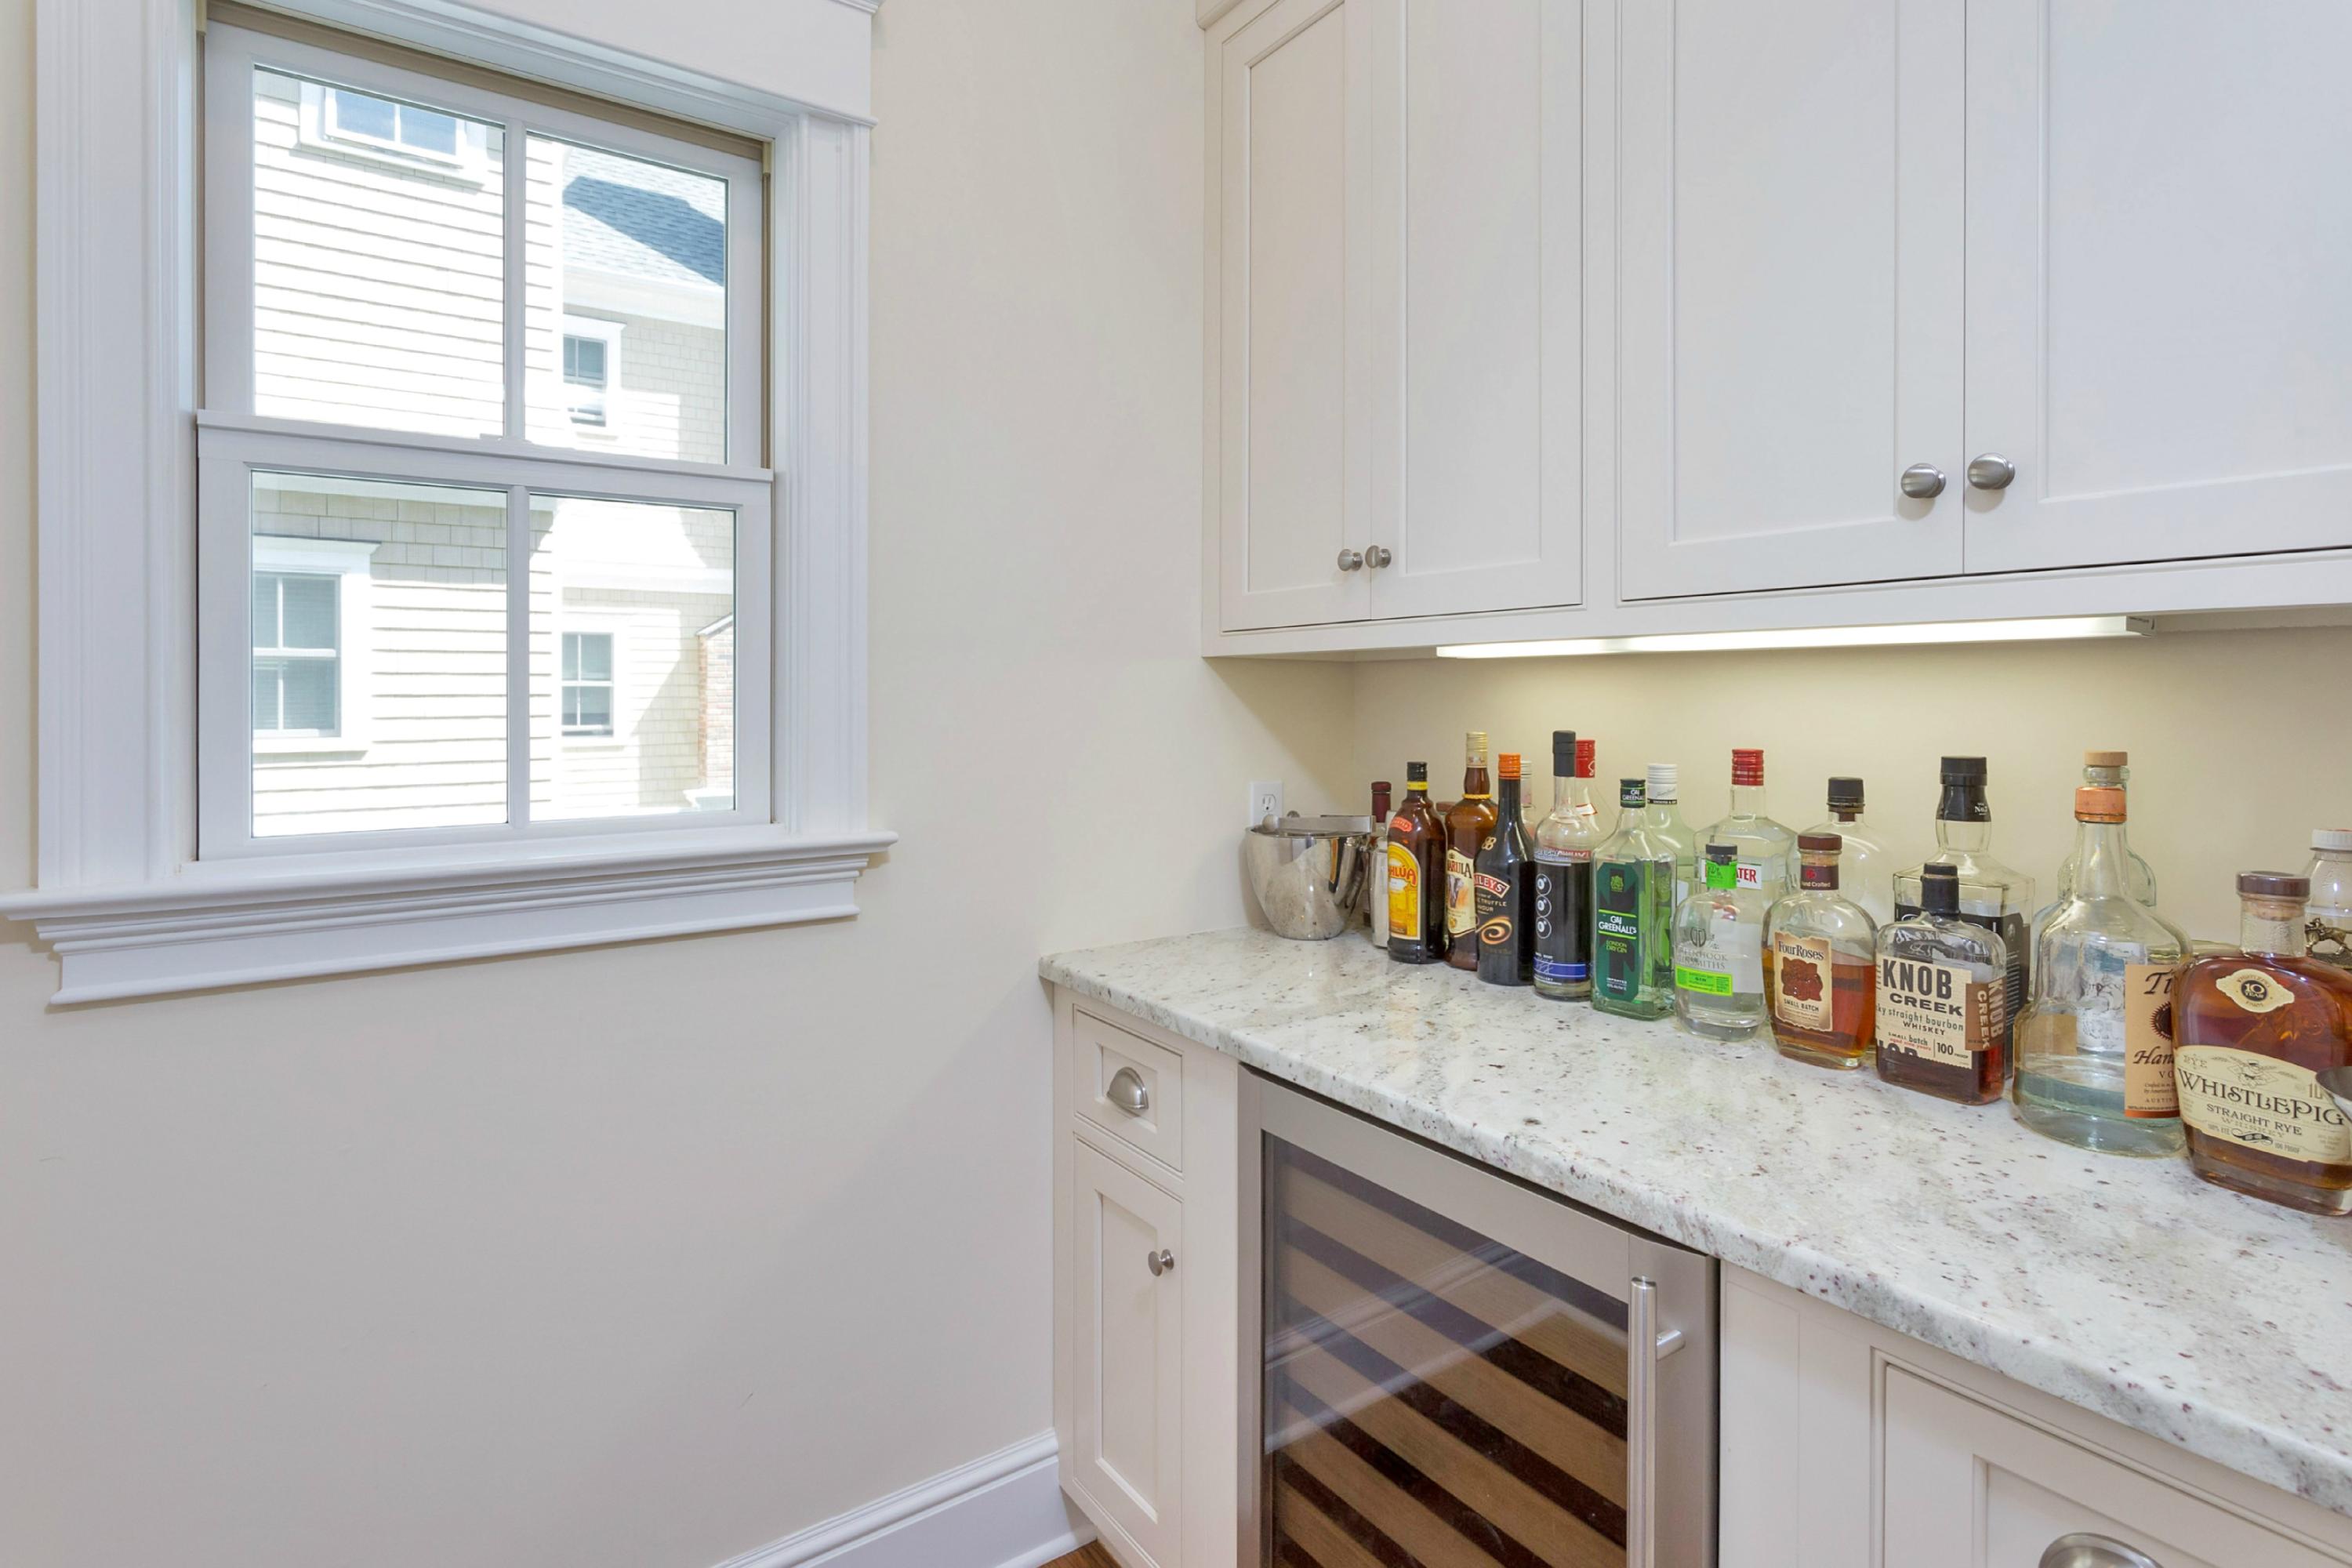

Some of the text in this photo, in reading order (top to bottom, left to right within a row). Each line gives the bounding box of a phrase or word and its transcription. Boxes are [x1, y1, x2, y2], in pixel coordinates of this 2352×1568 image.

[1883, 959, 1952, 1000] KNOB
[2245, 982, 2265, 994] 10
[1801, 1002, 1820, 1012] BATCH
[1889, 992, 1964, 1017] CREEK
[1988, 978, 2004, 1038] KNOB
[1888, 1009, 1923, 1023] straight
[1926, 1014, 1964, 1032] bourbon
[1903, 1021, 1946, 1036] WHISKEY
[1977, 990, 1991, 1050] CREEK
[1908, 1034, 1929, 1047] batch
[1937, 1042, 1955, 1055] 100
[2132, 1046, 2173, 1065] Han
[2177, 1067, 2345, 1126] WHISTLEPIG
[2206, 1103, 2270, 1127] STRAIGHT
[2274, 1121, 2303, 1136] RYE
